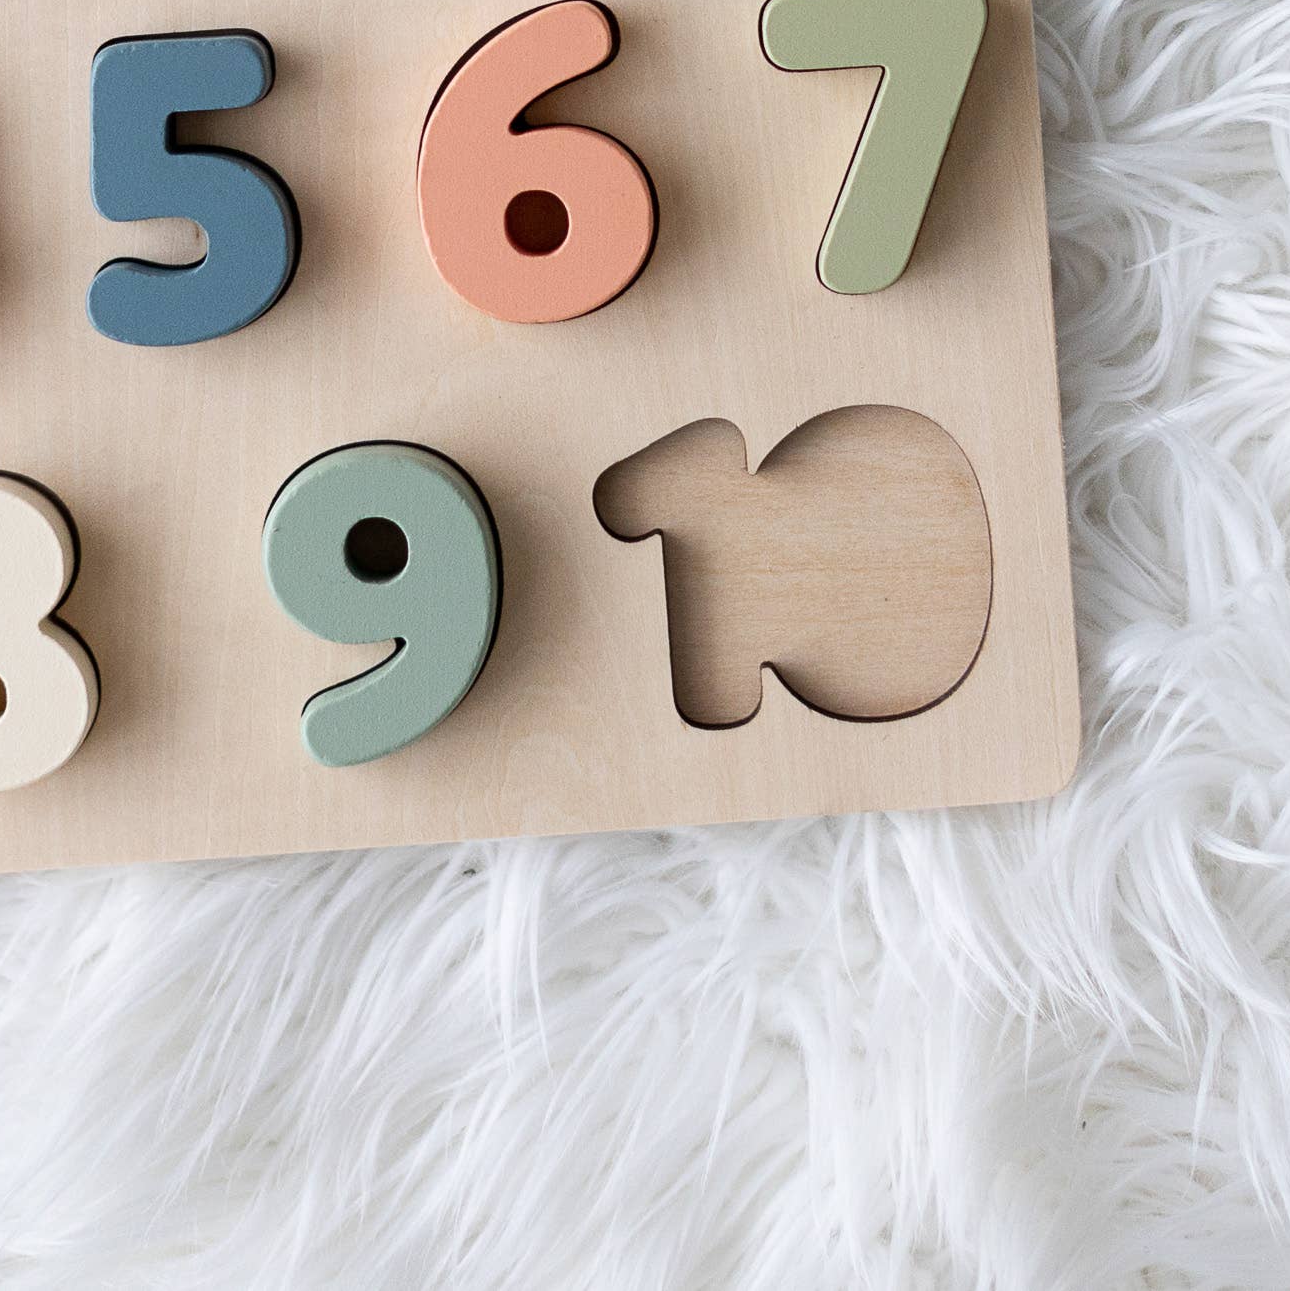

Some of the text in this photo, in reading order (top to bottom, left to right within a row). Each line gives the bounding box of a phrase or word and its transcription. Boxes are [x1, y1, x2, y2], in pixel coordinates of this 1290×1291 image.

[85, 30, 301, 348] 5
[418, 0, 658, 324] 6
[262, 440, 503, 770] 9
